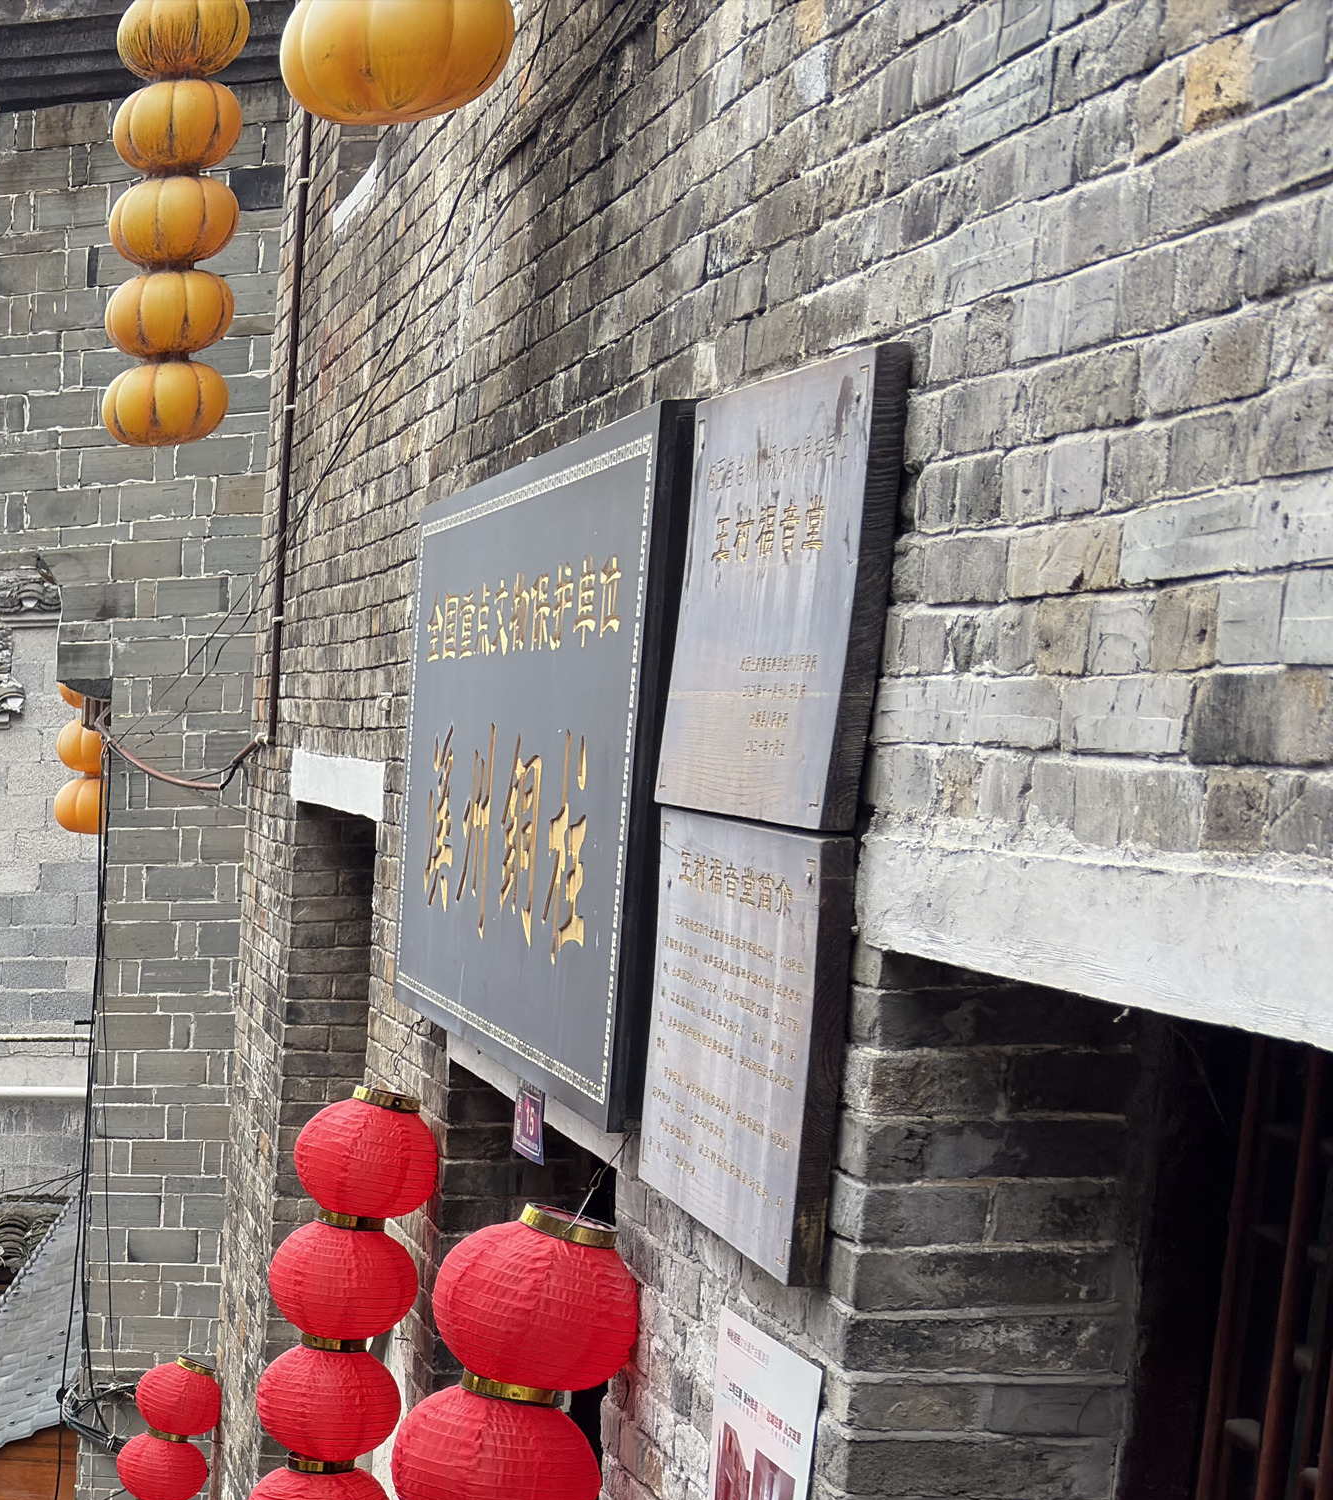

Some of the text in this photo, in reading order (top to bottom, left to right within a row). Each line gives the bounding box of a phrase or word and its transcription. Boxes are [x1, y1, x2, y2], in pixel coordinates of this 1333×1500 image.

[711, 494, 825, 563] 王村福音堂
[427, 552, 621, 662] 全国重点文物保护单位
[424, 720, 588, 965] 溪州铜柱
[678, 849, 793, 918] 王村福音堂简介
